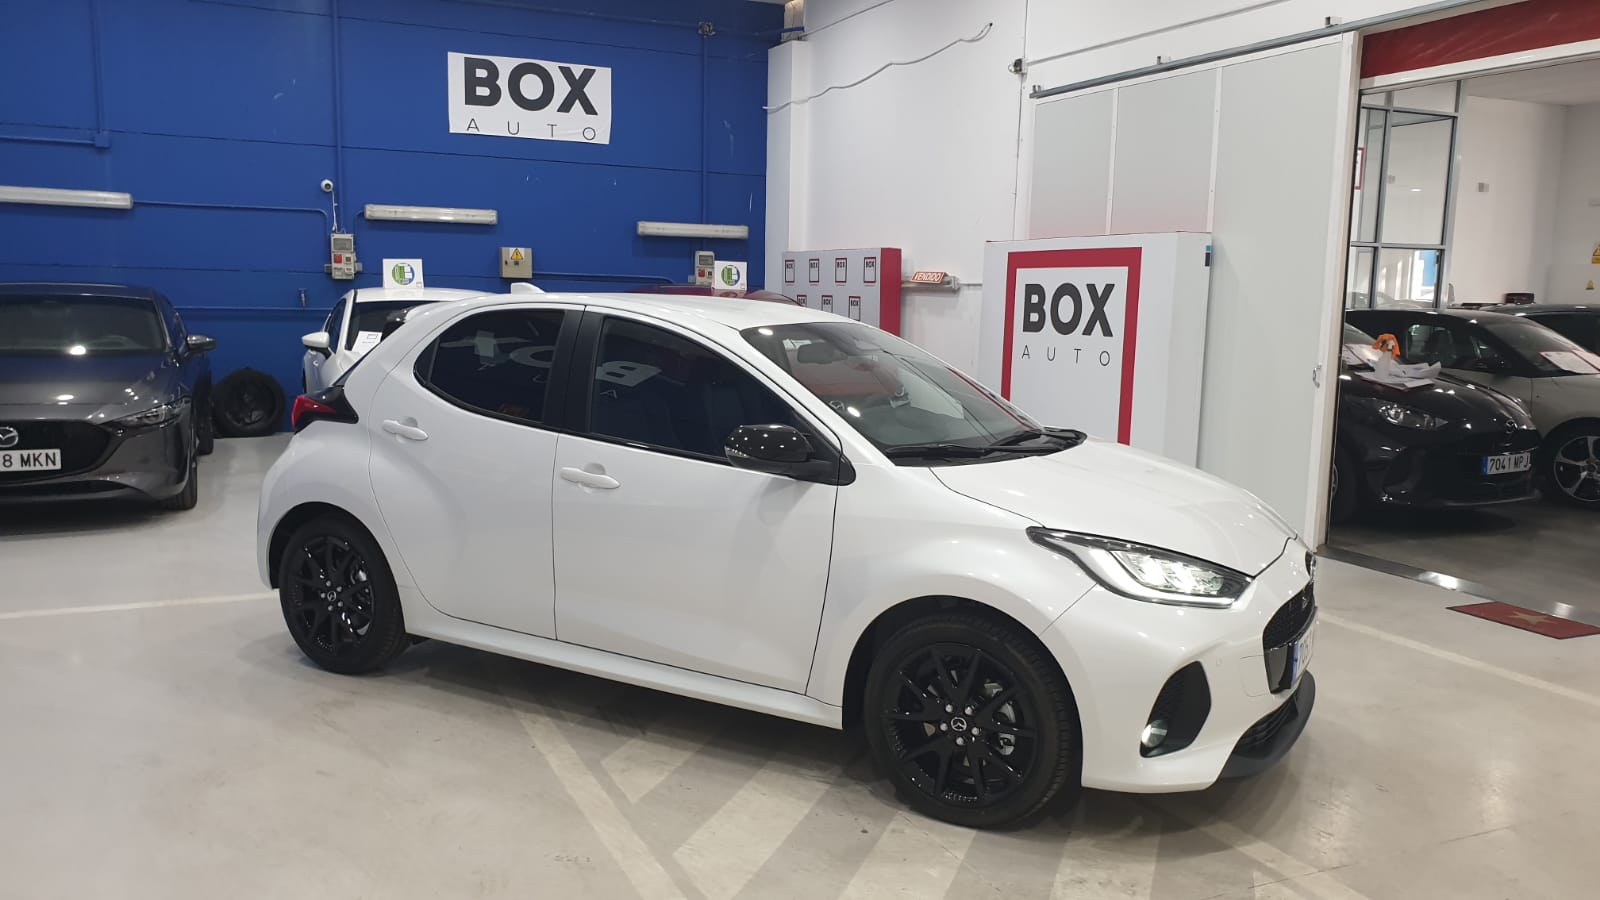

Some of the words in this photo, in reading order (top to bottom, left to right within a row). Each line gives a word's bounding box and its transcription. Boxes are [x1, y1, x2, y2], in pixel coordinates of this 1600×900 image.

[464, 56, 598, 116] BOX
[466, 118, 596, 141] AUTO
[1022, 282, 1116, 338] BOX
[1021, 344, 1111, 366] AUTO
[2, 454, 13, 468] 8
[20, 452, 57, 468] MKN
[1489, 457, 1511, 472] 7041
[1514, 455, 1530, 469] MPJ
